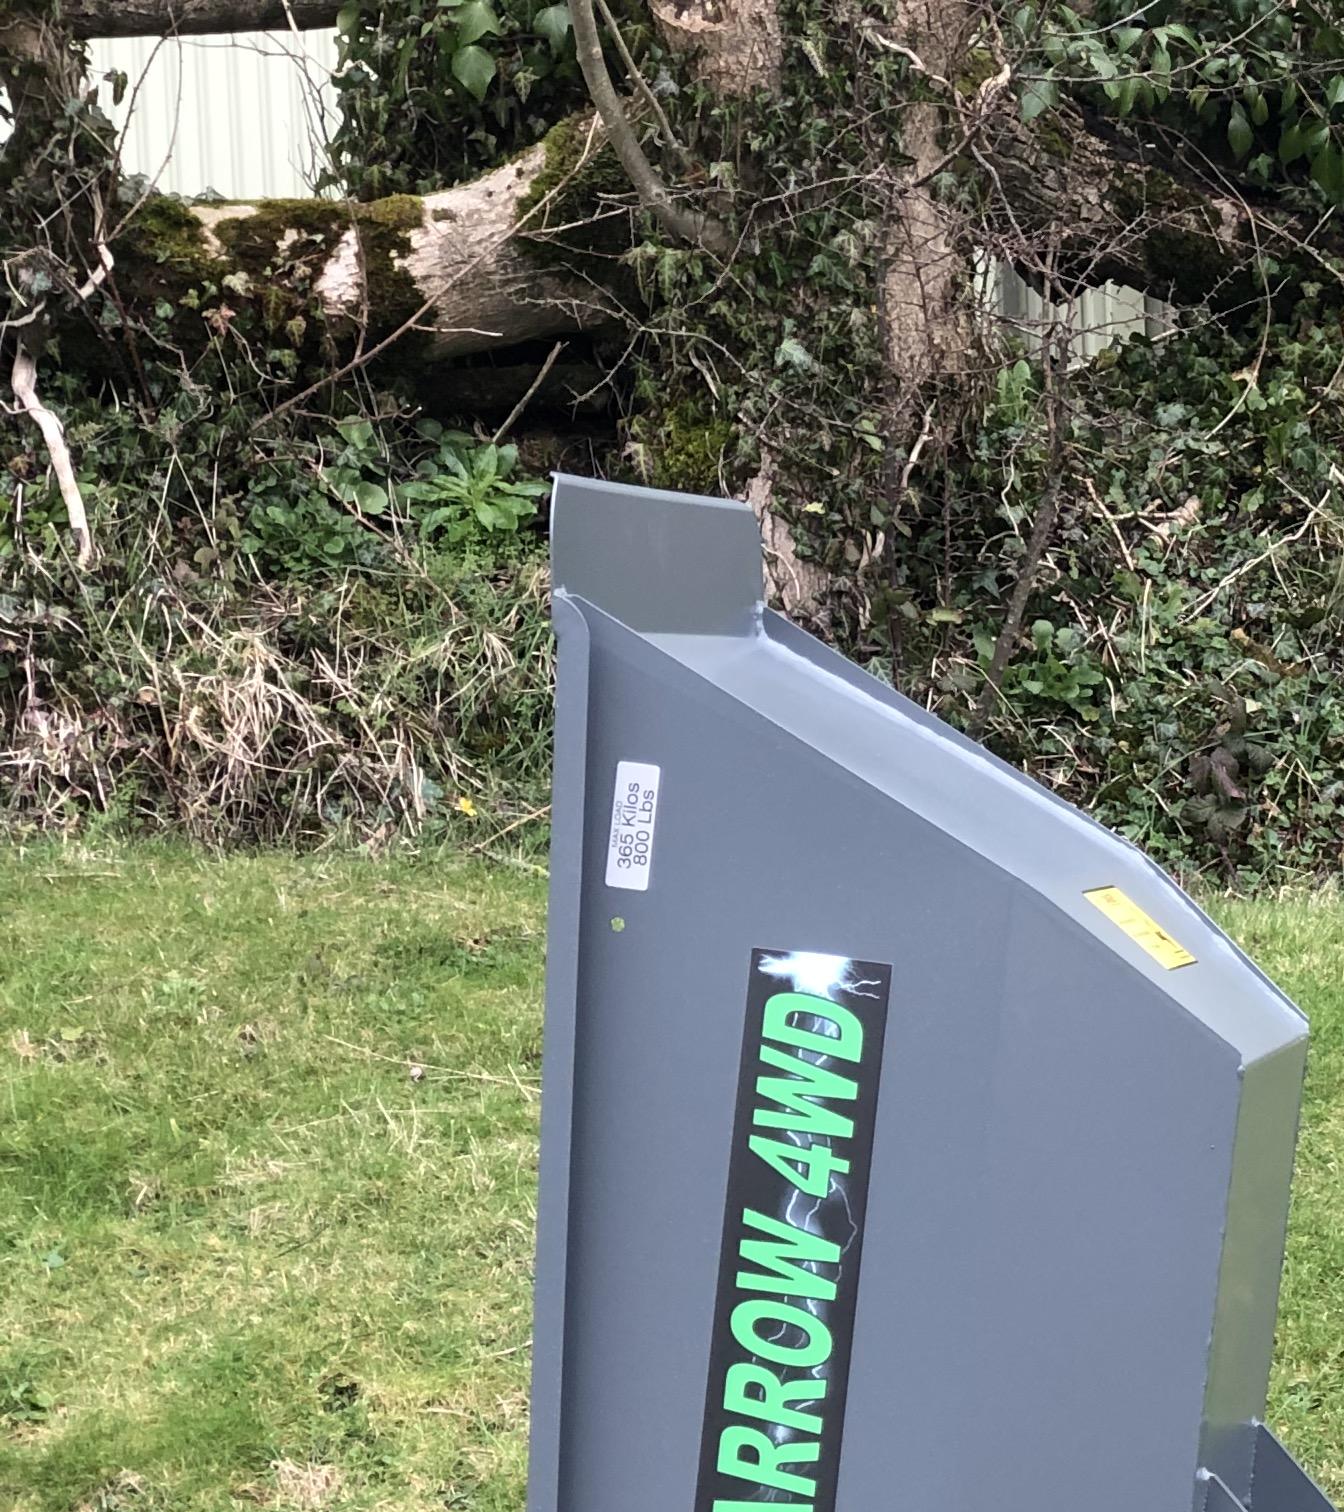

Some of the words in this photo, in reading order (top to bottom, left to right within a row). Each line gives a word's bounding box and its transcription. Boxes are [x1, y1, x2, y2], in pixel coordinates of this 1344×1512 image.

[615, 801, 624, 825] LOAD
[622, 782, 640, 827] Kilos
[638, 790, 655, 824] Lbs
[611, 828, 620, 848] MAX
[617, 834, 634, 869] 365
[633, 830, 650, 866] 800
[749, 993, 862, 1197] 4WD
